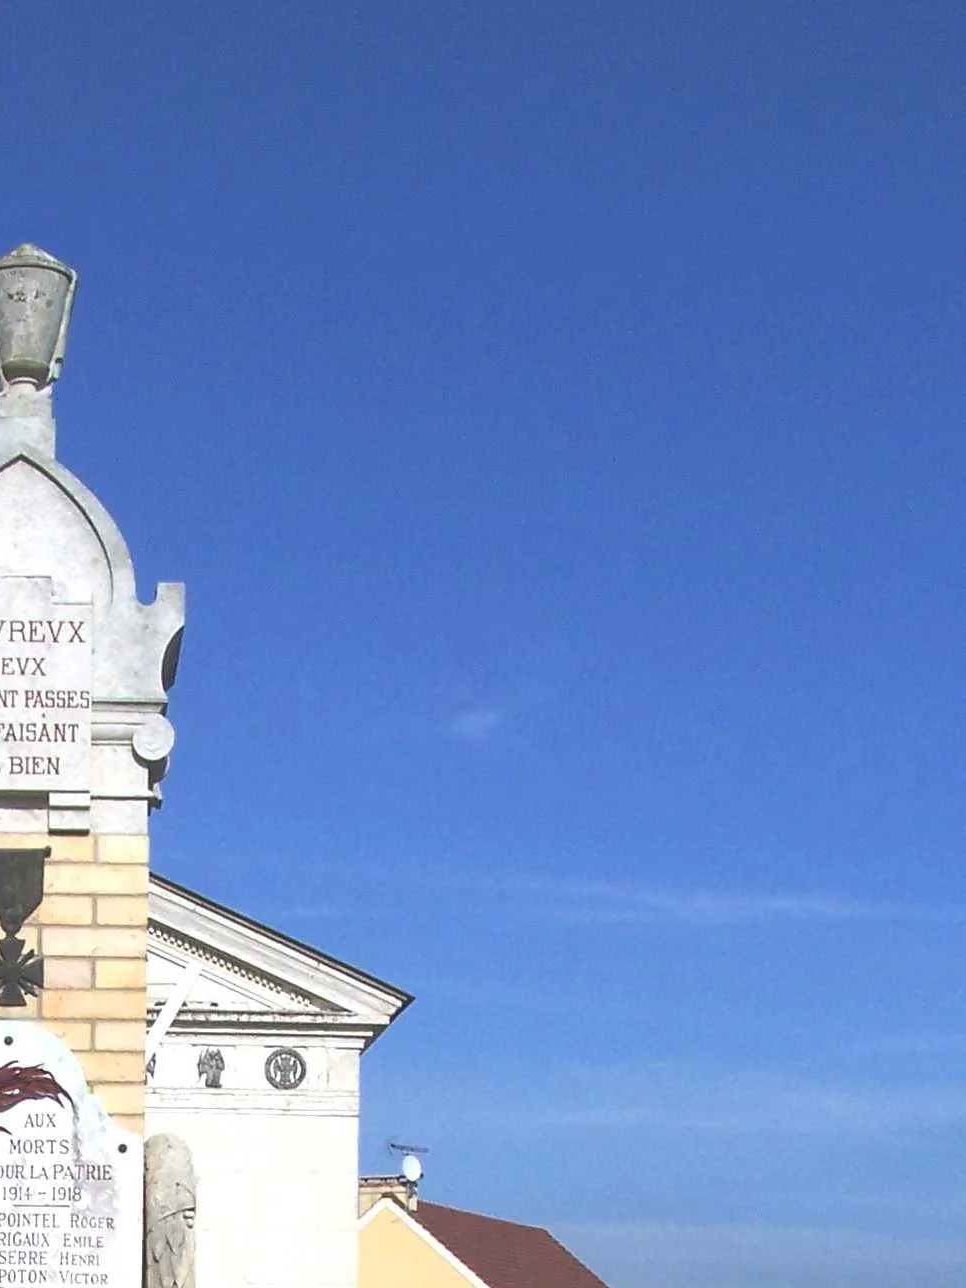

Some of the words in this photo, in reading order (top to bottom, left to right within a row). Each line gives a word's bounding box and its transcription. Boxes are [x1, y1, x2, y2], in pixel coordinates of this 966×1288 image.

[24, 690, 90, 709] PASSES
[9, 756, 60, 775] BIEN
[24, 1113, 56, 1128] AUX
[9, 1139, 70, 1154] MORTS
[30, 1164, 49, 1180] LA
[53, 1164, 113, 1181] PATRIE
[2, 1186, 33, 1201] 1914
[52, 1186, 82, 1202] 1918
[70, 1213, 115, 1229] ROGER
[63, 1232, 104, 1248] EMILE
[59, 1251, 100, 1266] HENRI
[59, 1269, 108, 1285] VICTOR
